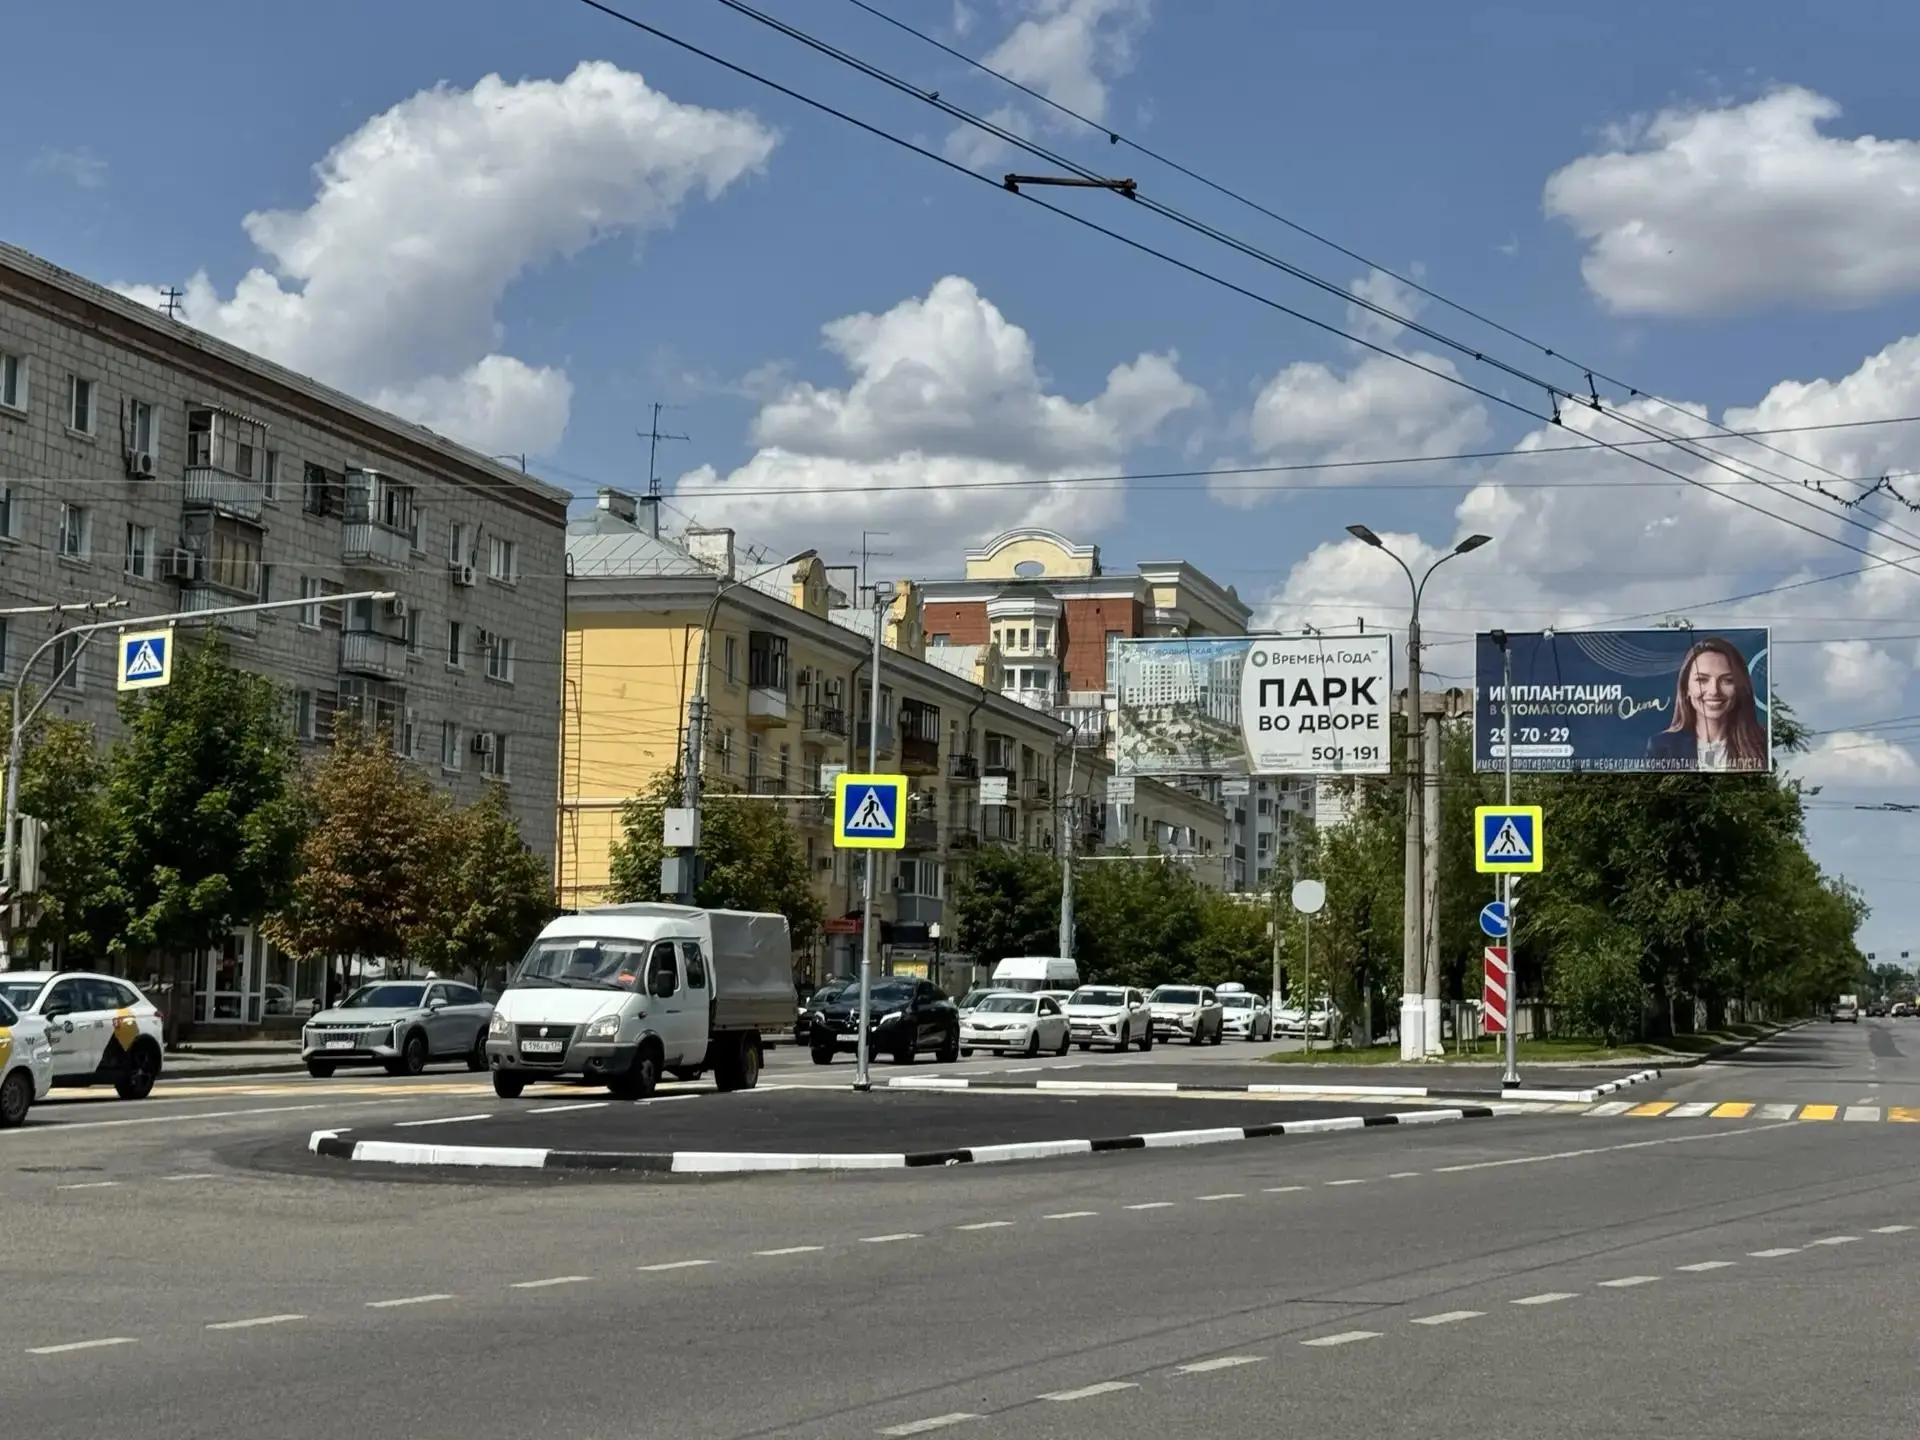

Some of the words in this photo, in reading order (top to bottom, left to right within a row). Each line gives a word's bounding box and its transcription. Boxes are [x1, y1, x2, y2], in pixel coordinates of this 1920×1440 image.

[1490, 685, 1622, 703] ИМПЛАНТАЦИЯ
[1490, 704, 1497, 716] В
[1259, 715, 1290, 731] ВО
[1298, 713, 1379, 734] ДВОРЕ
[1312, 746, 1379, 760] 501-191
